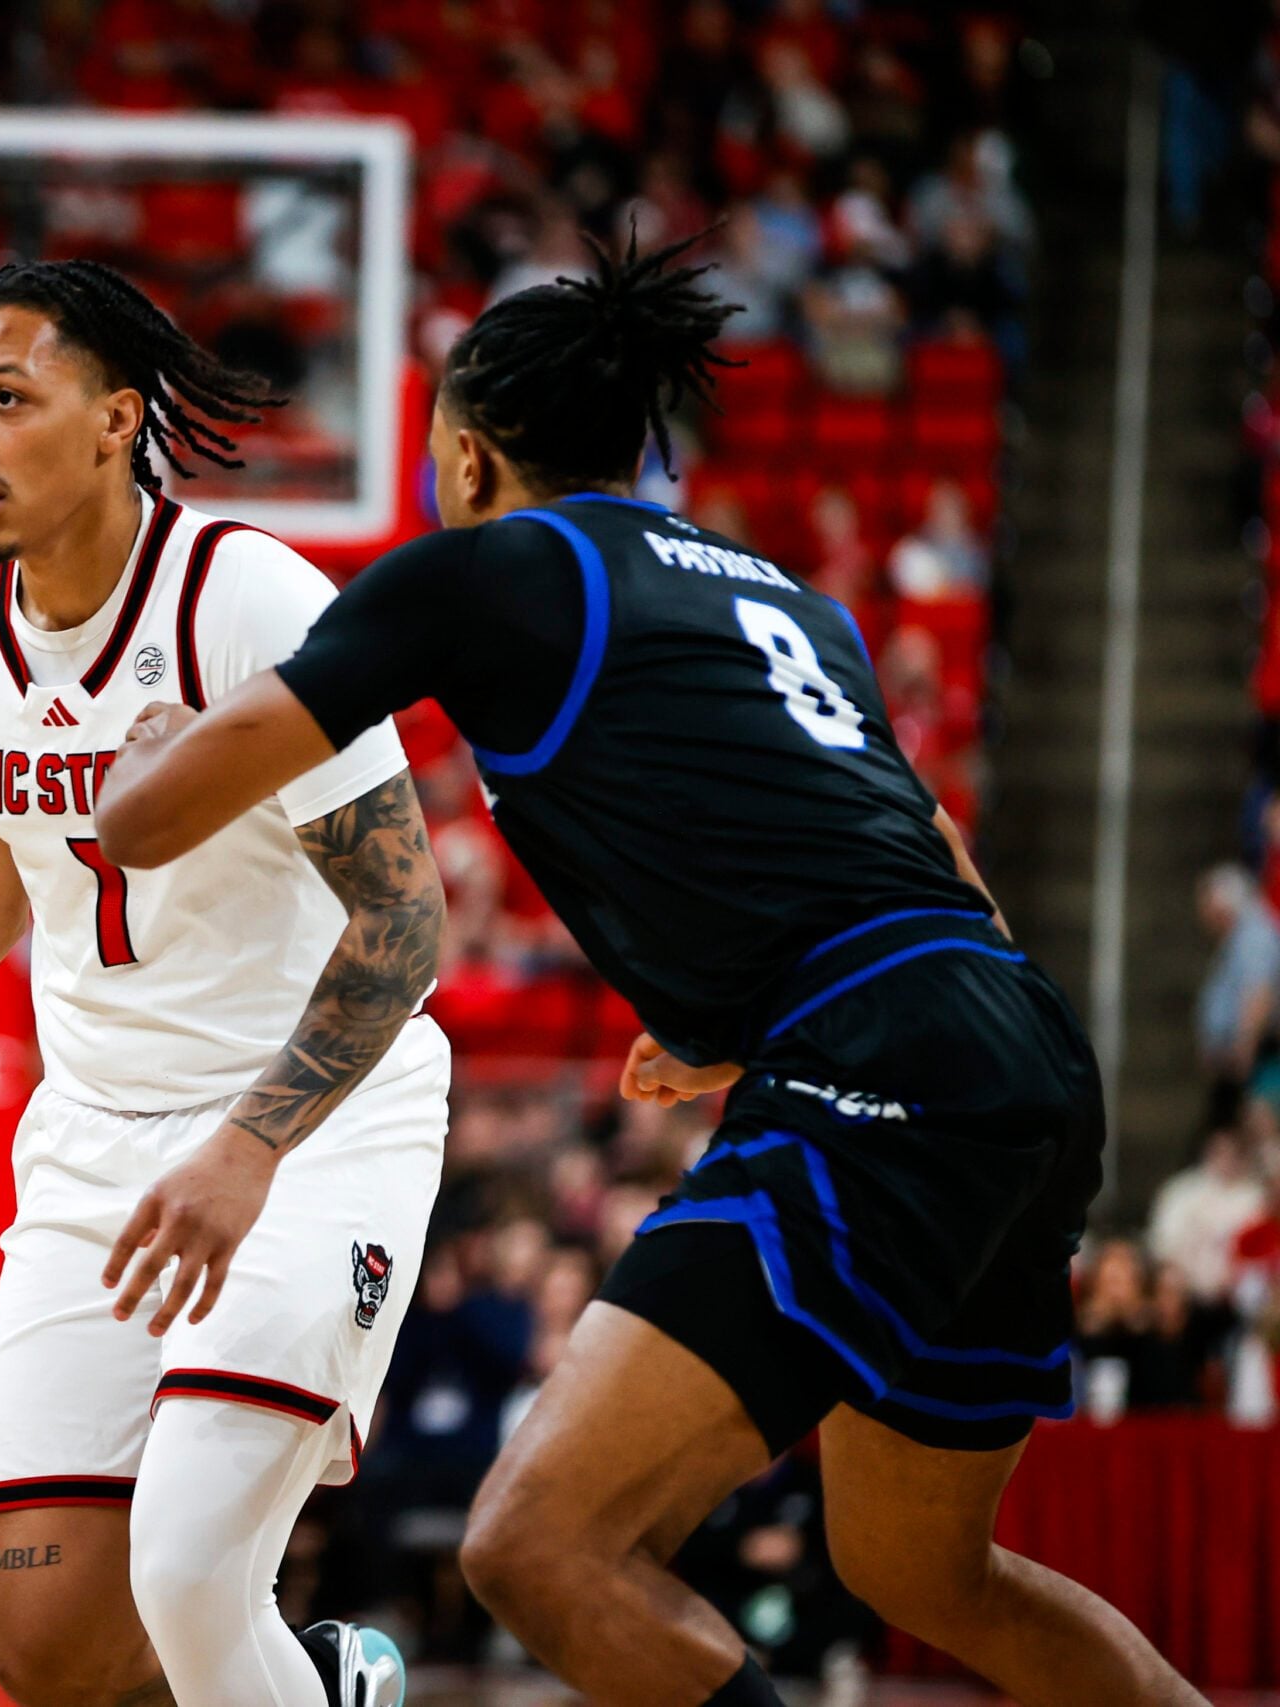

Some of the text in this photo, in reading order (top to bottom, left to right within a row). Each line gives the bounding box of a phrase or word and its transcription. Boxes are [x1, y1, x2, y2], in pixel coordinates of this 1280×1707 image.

[643, 530, 802, 592] PATRICK
[138, 657, 164, 668] ACC
[65, 836, 139, 968] 1
